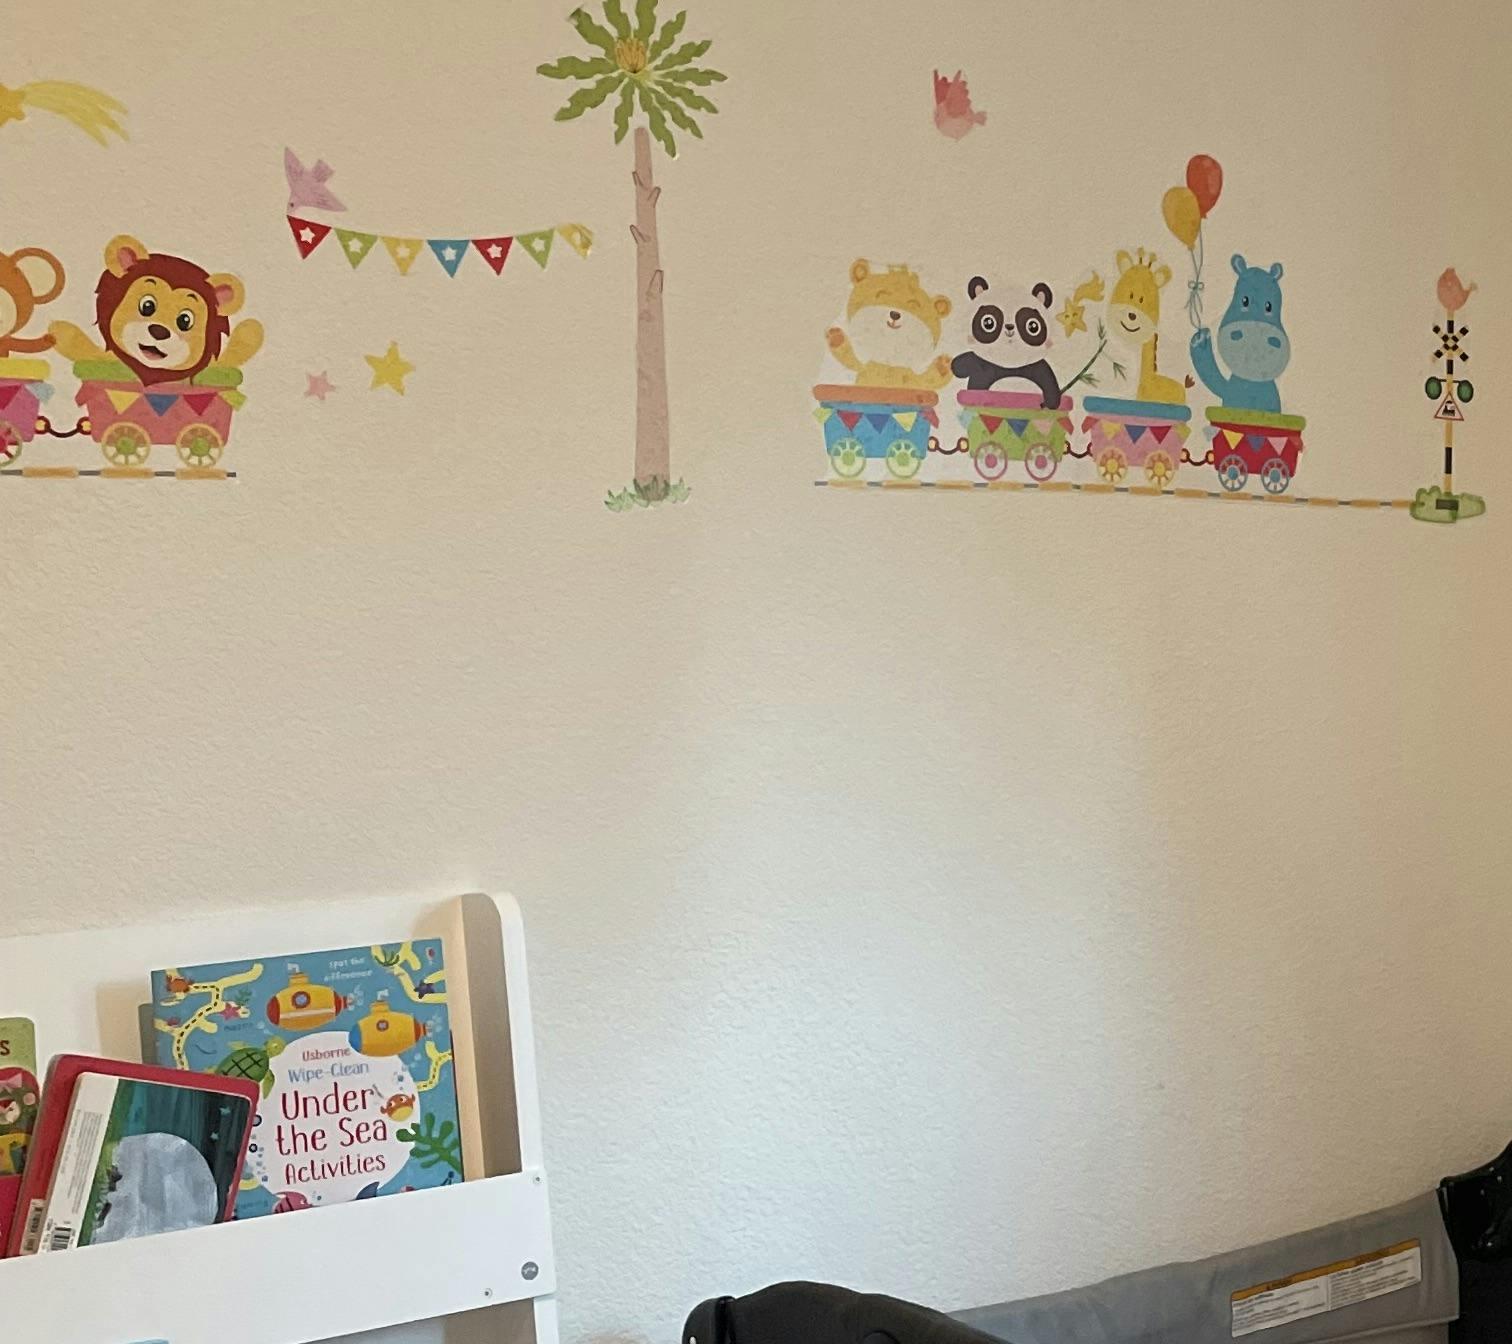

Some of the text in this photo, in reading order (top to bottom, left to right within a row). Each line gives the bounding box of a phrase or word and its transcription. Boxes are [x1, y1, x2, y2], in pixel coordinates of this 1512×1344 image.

[302, 1047, 350, 1062] Usborne
[287, 1062, 369, 1084] Wipe-Clean
[281, 1081, 374, 1120] Under
[275, 1117, 388, 1156] the Sea
[284, 1155, 386, 1185] Activities
